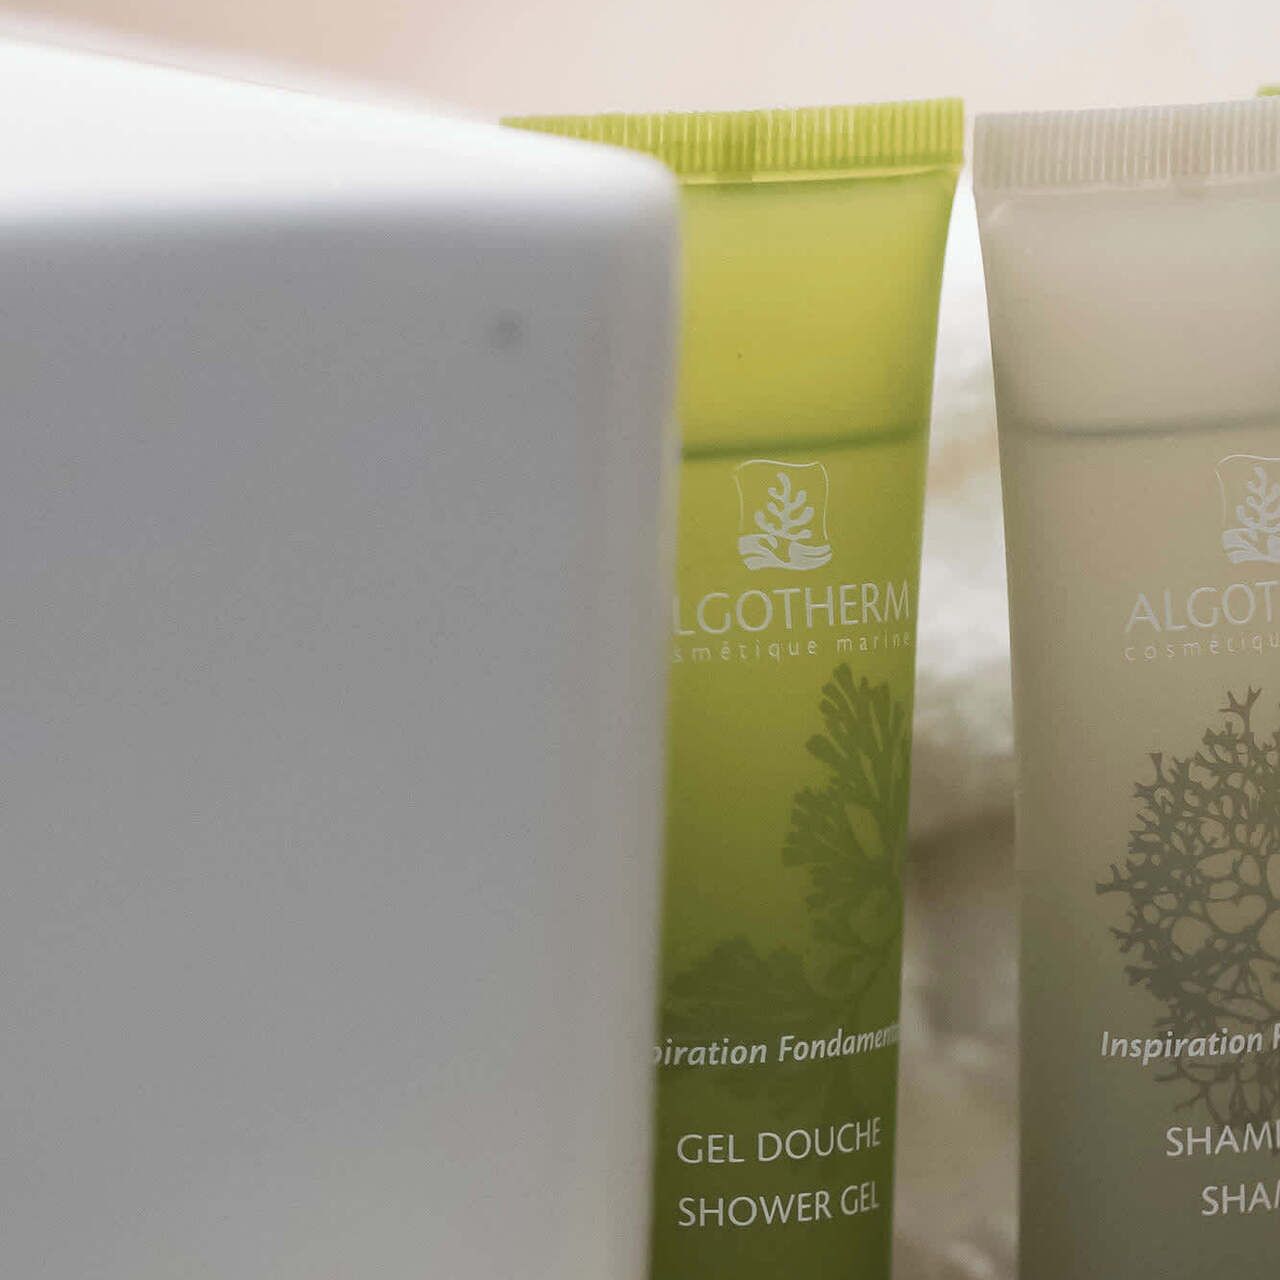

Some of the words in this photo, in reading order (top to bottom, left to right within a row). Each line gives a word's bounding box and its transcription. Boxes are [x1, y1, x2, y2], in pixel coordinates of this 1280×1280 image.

[671, 579, 911, 636] LGOTHERM
[671, 638, 818, 663] smétique
[652, 1037, 768, 1067] iration
[1100, 1027, 1263, 1066] Inspiration
[677, 1133, 745, 1164] GEL
[757, 1117, 882, 1162] DOUCHE
[678, 1191, 832, 1227] SHOWER
[841, 1181, 880, 1216] GEL
